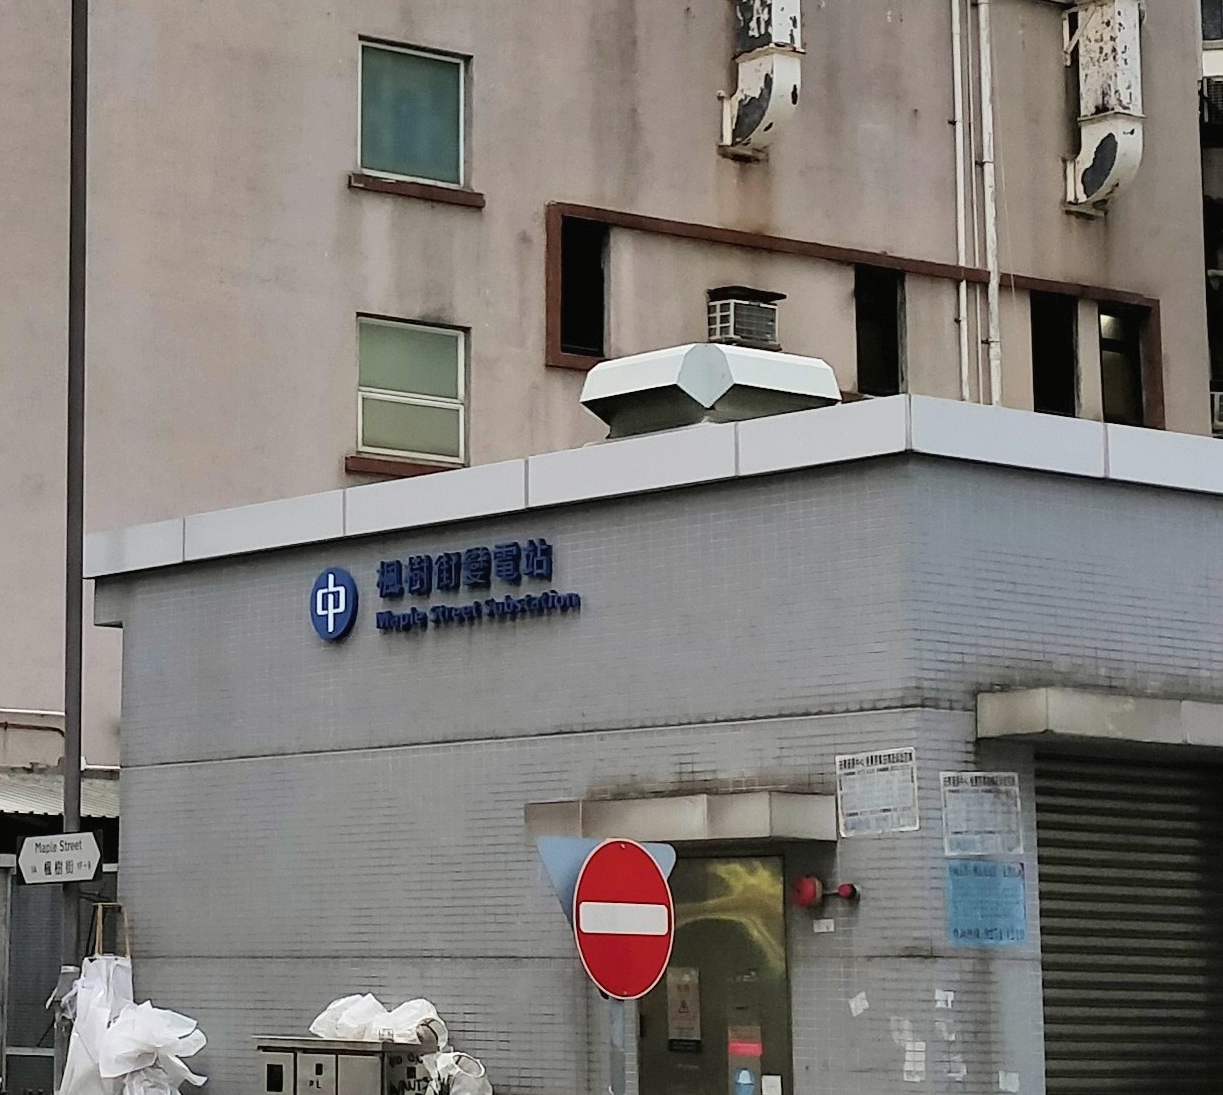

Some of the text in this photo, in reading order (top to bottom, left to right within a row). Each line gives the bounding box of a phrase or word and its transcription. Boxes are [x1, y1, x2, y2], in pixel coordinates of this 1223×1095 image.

[377, 538, 553, 598] 楓樹街變電站
[377, 590, 581, 633] Maple Street Substation
[35, 840, 82, 854] Maple Street
